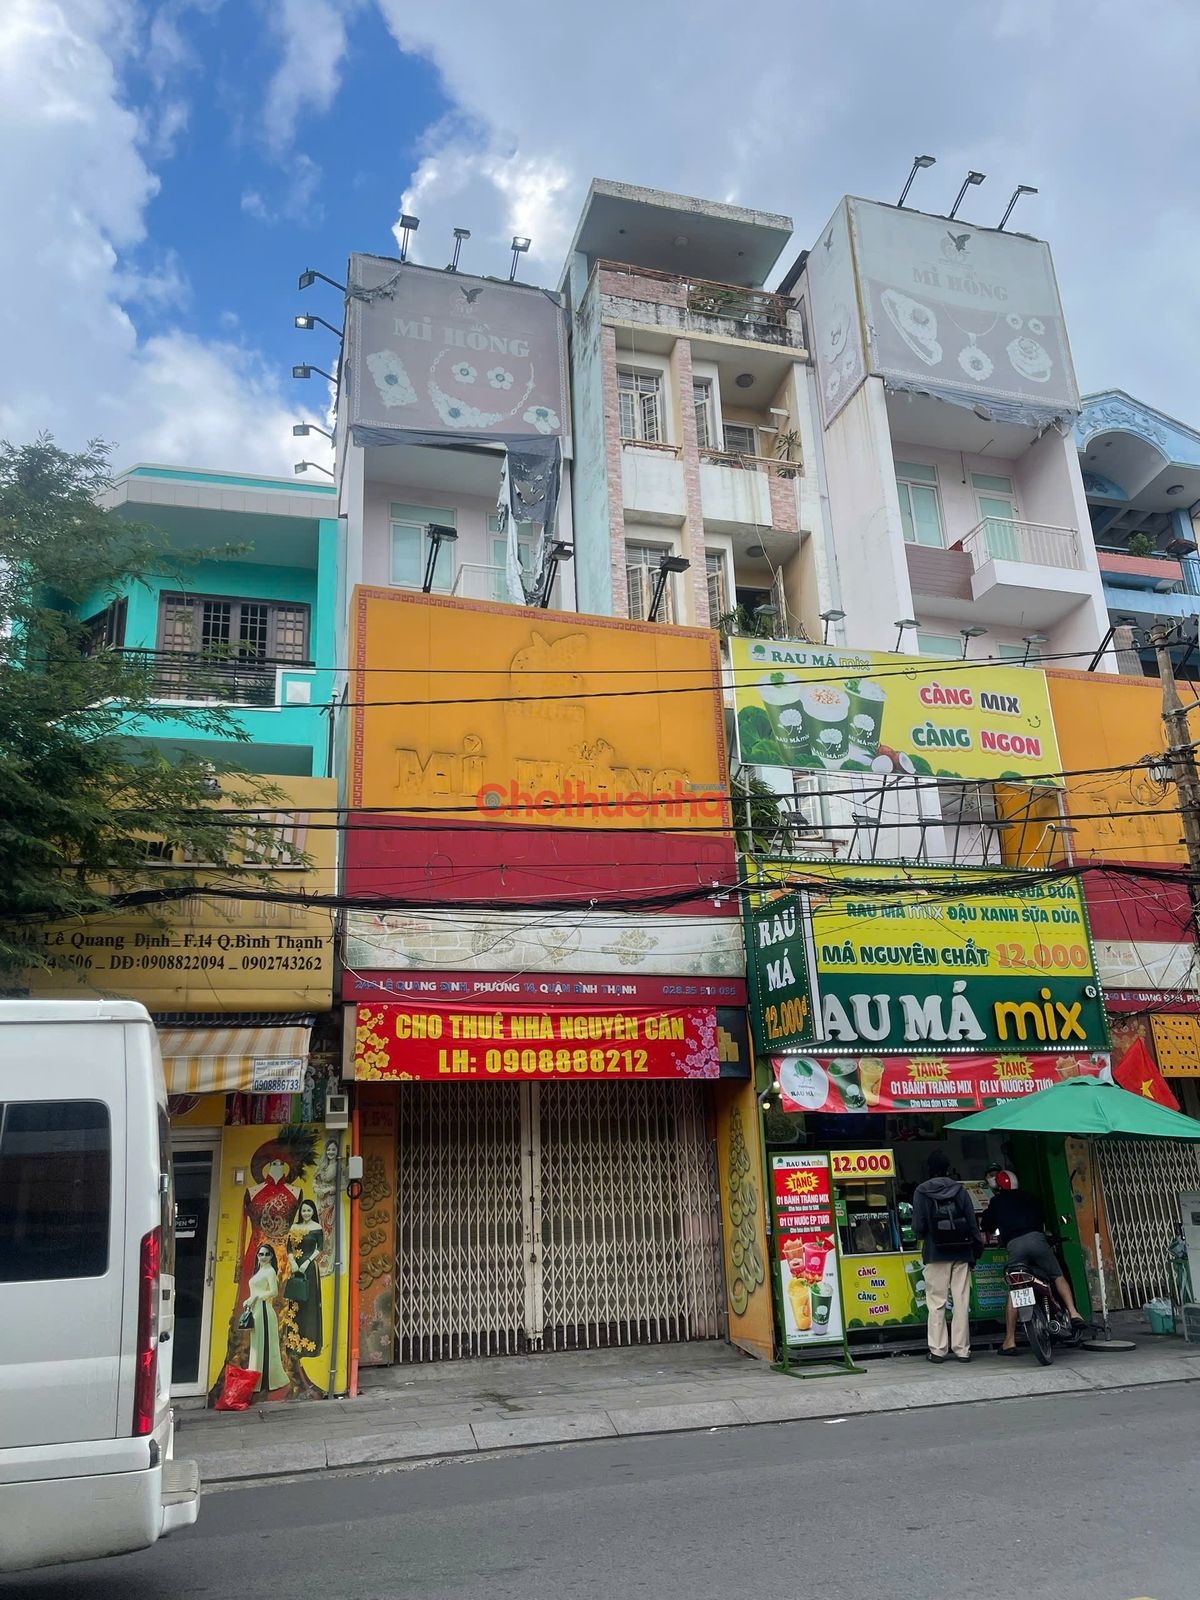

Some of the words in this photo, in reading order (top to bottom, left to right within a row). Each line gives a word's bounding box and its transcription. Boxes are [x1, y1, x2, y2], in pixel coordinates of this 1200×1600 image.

[771, 651, 806, 664] RAU
[812, 654, 836, 667] MÁ
[840, 656, 870, 671] mix
[920, 682, 973, 705] CÀNG
[981, 692, 1020, 714] MIX
[912, 722, 971, 747] CÀNG
[981, 731, 1041, 756] NGON
[847, 903, 877, 917] RAU
[946, 903, 977, 924] ĐẬU
[980, 906, 1018, 922] XANH
[1022, 905, 1049, 923] SỮA
[1051, 905, 1080, 923] DỪA
[758, 907, 796, 948] RAU
[71, 932, 125, 949] Quang
[217, 934, 270, 950] Q.Bình
[275, 935, 323, 951] Thạnh
[823, 940, 855, 964] MÁ
[860, 942, 938, 965] NGUYÊN
[941, 938, 989, 966] CHẤT
[995, 943, 1088, 968] 12.000
[242, 956, 322, 970] 0902743262
[766, 948, 796, 992] MÁ
[380, 978, 393, 990] LÊ
[396, 982, 437, 992] QUANG
[540, 983, 571, 996] QUẬN
[574, 982, 598, 994] BÌNH
[602, 984, 637, 997] THẠNH
[823, 994, 892, 1042] AU
[899, 980, 987, 1042] MÁ
[993, 987, 1088, 1041] mix
[395, 1014, 443, 1040] CHO
[449, 1011, 505, 1040] THUÊ
[510, 1012, 555, 1040] NHÀ
[560, 1013, 639, 1041] NGUYÊN
[645, 1012, 685, 1041] CĂN
[438, 1049, 477, 1074] LH:
[485, 1048, 649, 1074] 0908888212
[890, 1081, 901, 1094] 01
[902, 1079, 927, 1095] BÁNH
[957, 1080, 973, 1094] MIX
[979, 1080, 990, 1094] 01
[991, 1081, 1000, 1094] LY
[832, 1154, 891, 1173] 12.000
[858, 1267, 876, 1277] CÀNG
[870, 1279, 885, 1287] MIX
[858, 1291, 876, 1301] CÀNG
[869, 1304, 889, 1314] NGON
